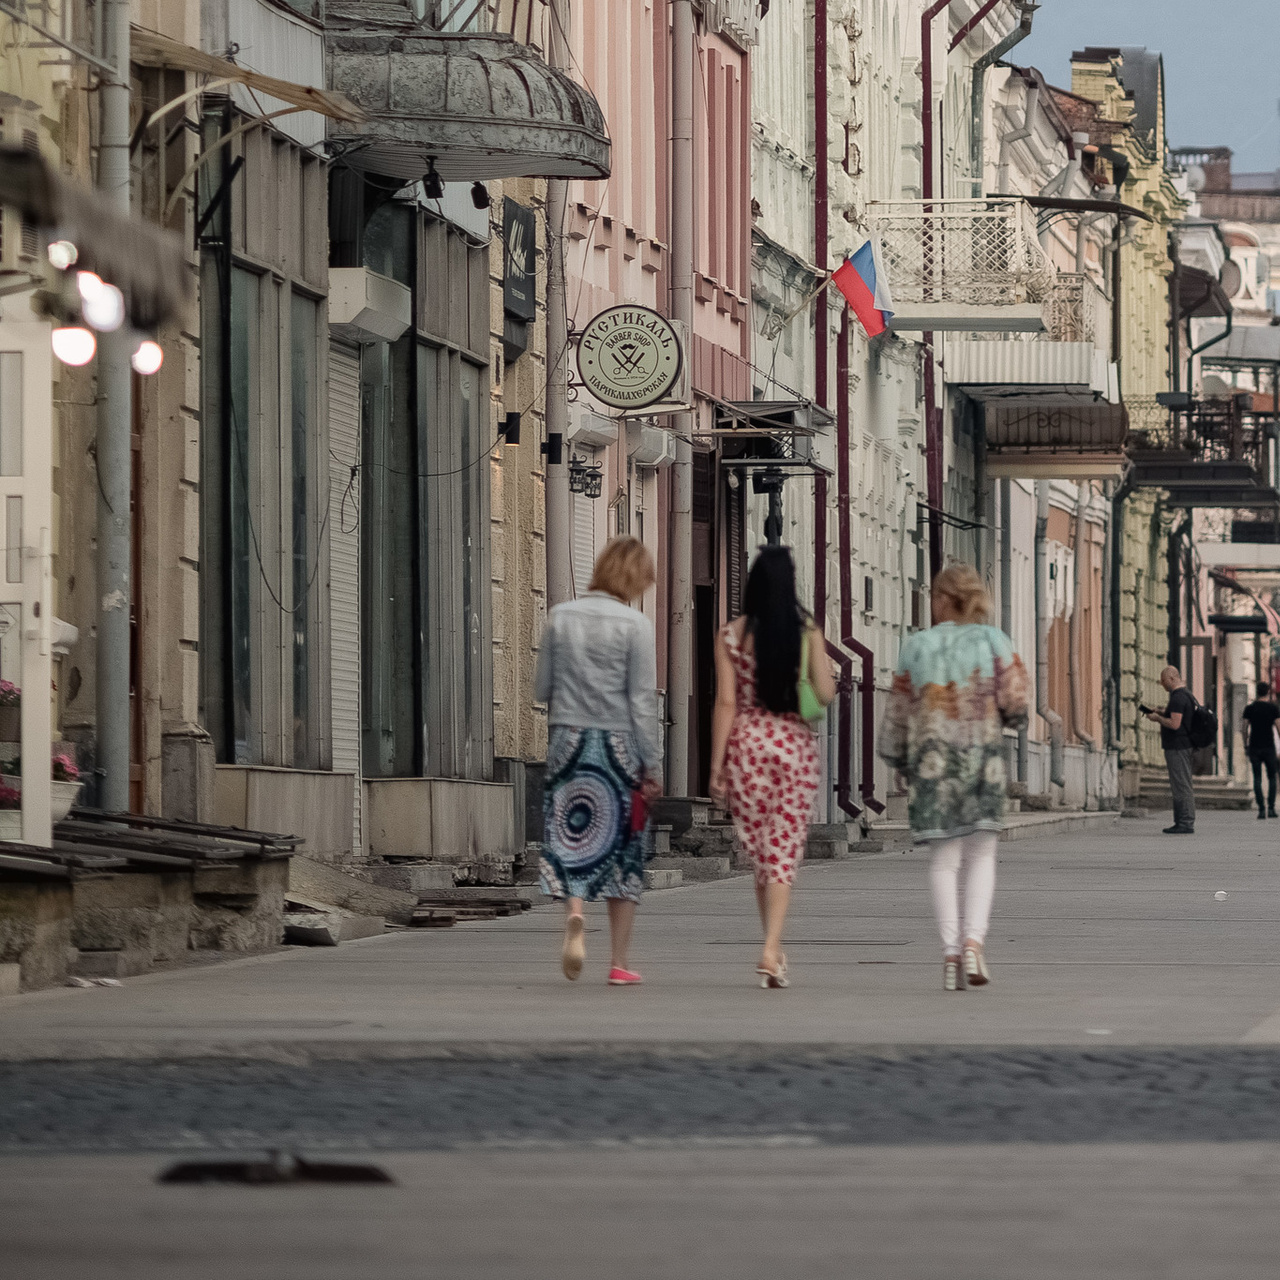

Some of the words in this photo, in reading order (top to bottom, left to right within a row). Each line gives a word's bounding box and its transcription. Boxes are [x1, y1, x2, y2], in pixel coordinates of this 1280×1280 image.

[583, 312, 673, 352] РУСТИКАЛЬ
[605, 331, 632, 349] BARBER
[633, 333, 651, 347] SHOP
[589, 372, 668, 400] ПАРИКМАХЕРСКАЯ
